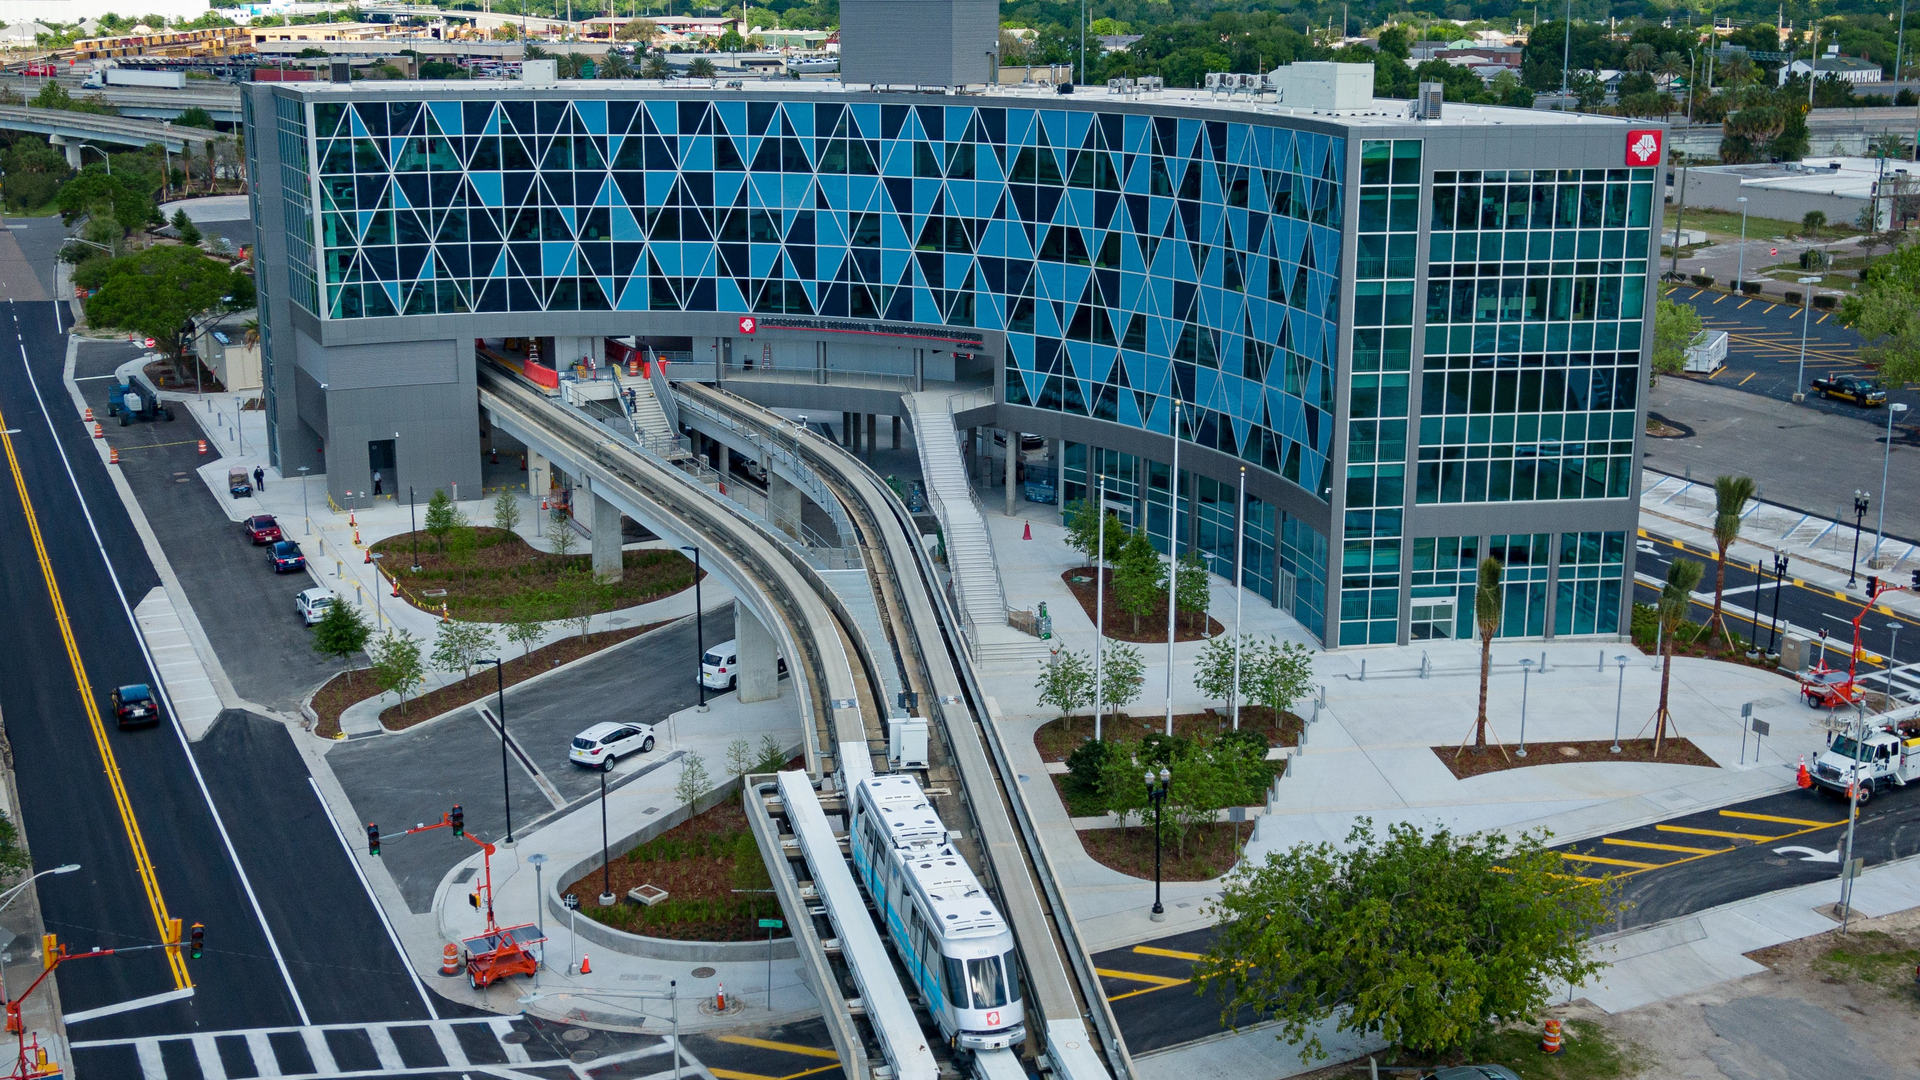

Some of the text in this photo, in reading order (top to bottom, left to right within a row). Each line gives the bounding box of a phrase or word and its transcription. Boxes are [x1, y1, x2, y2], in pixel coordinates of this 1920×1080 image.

[760, 318, 983, 341] JACKSONVILLE REGIONAL TRANSPORTATION CENTER
